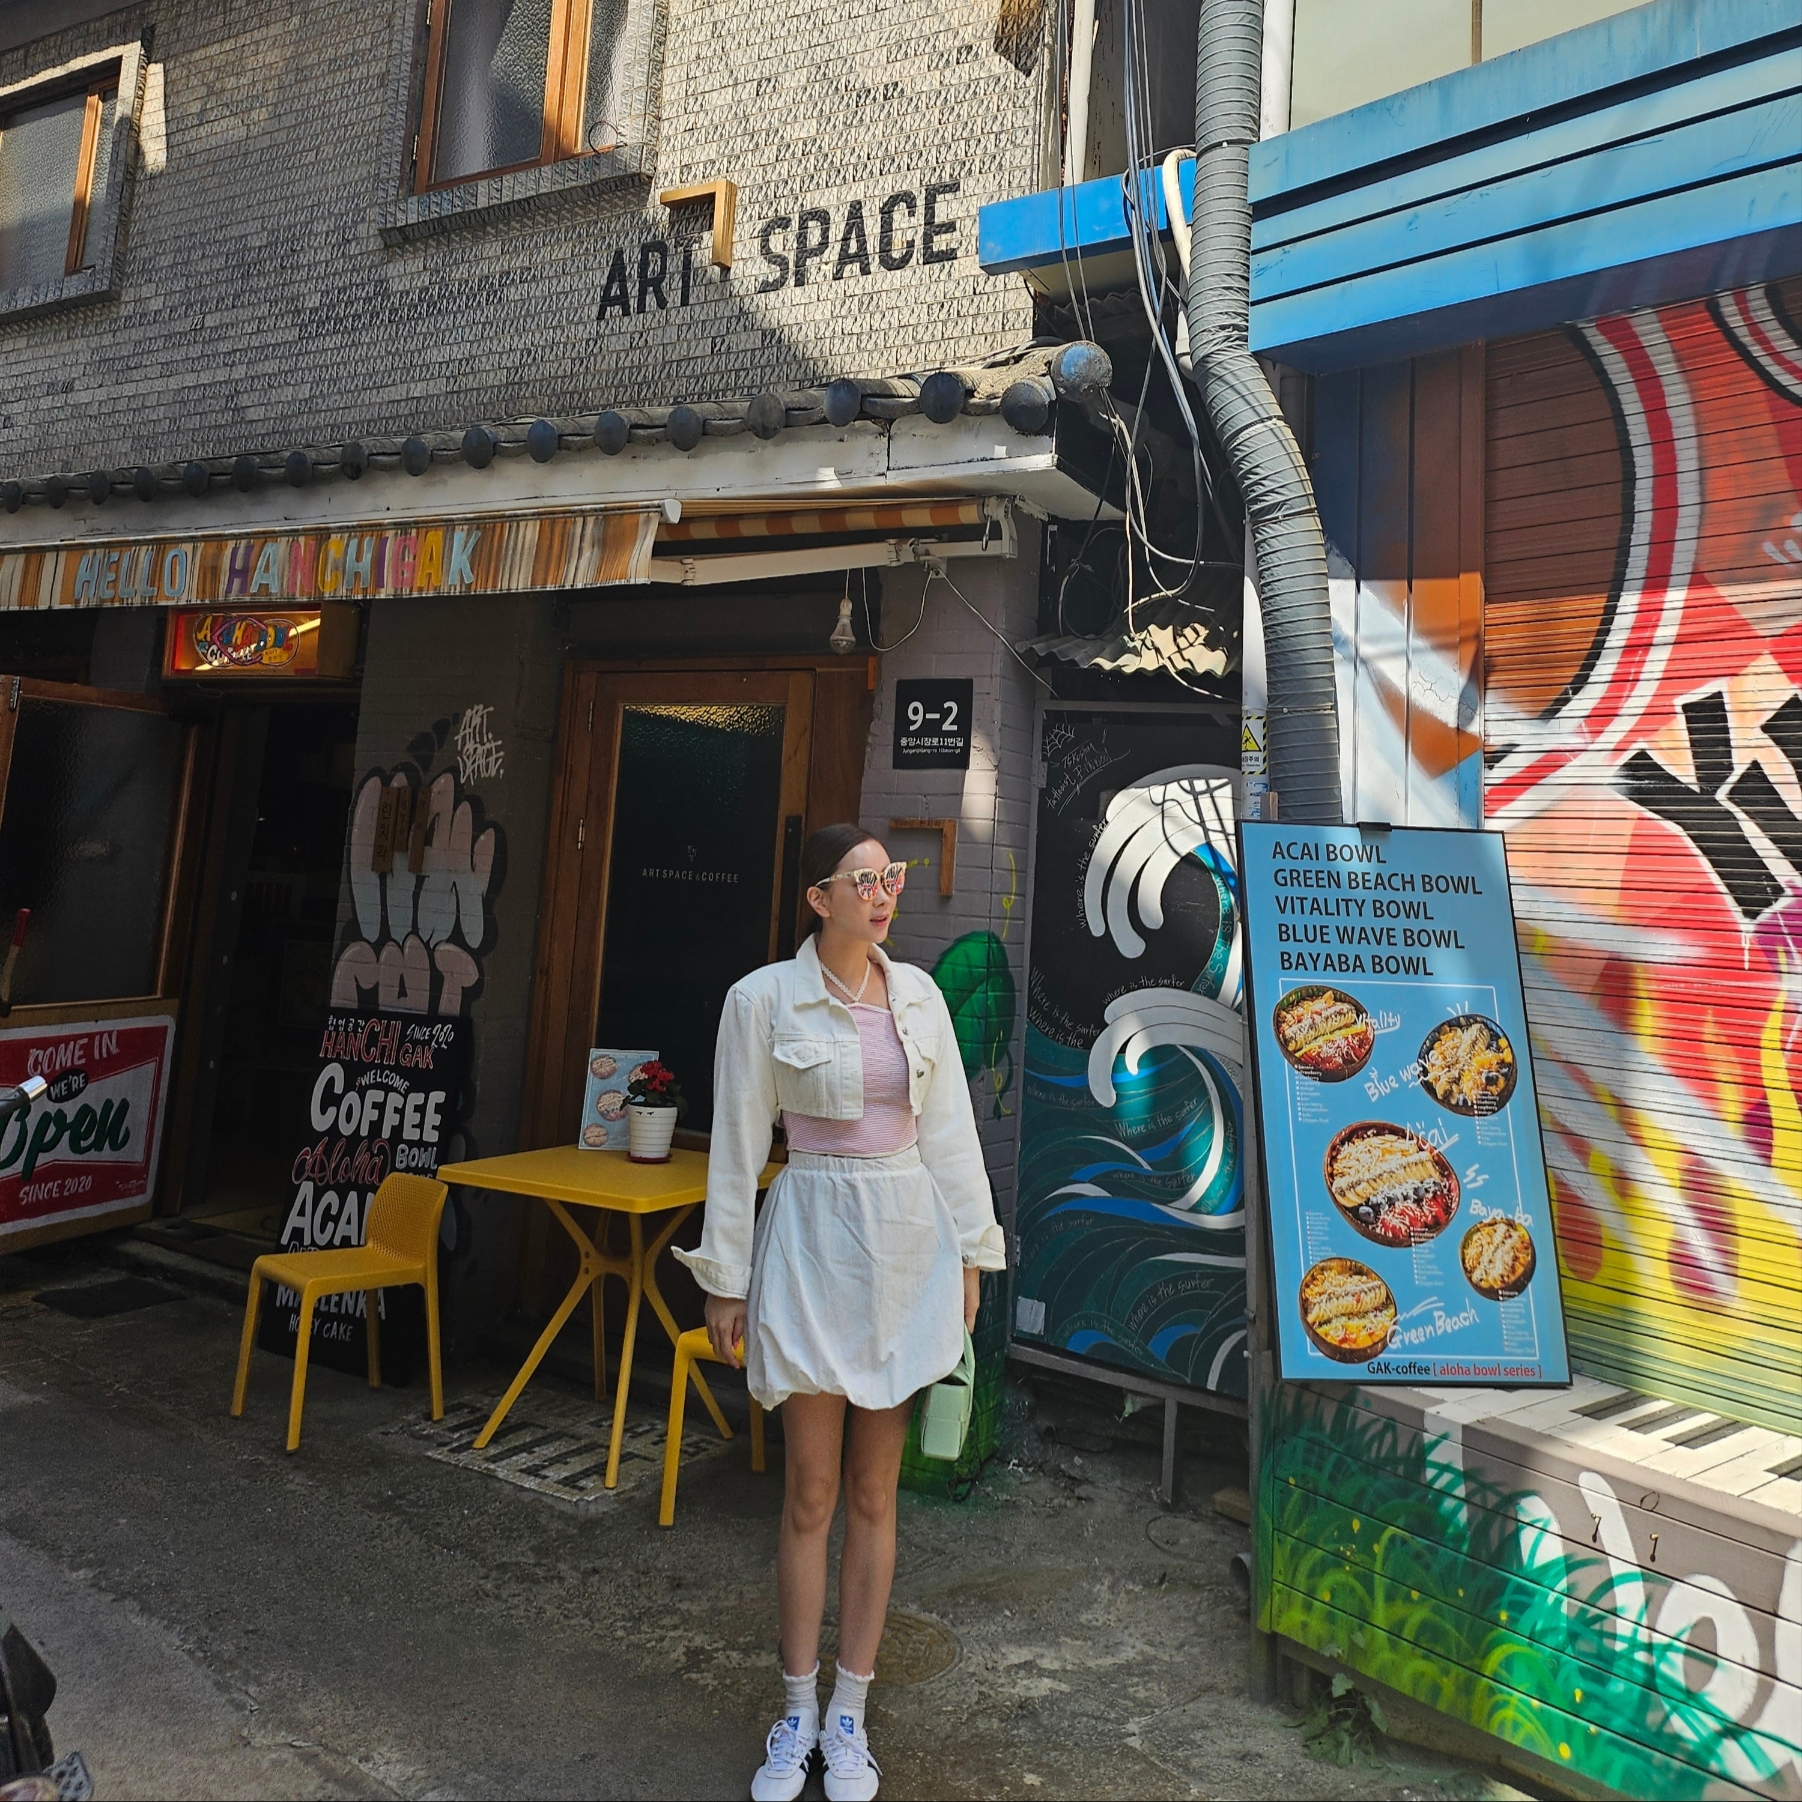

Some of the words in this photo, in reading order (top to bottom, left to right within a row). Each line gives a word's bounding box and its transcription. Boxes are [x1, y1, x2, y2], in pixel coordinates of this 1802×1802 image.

[597, 237, 702, 321] ART
[756, 181, 962, 294] SPACE
[74, 546, 188, 599] HELLO
[225, 529, 481, 596] HANCHIGAK
[907, 701, 959, 731] 9-2
[900, 737, 964, 747] 중앙시장로11번길
[1088, 817, 1109, 849] surfer
[1077, 852, 1091, 871] the
[1272, 841, 1320, 861] ACAI
[1325, 843, 1387, 864] BOWL
[701, 872, 739, 883] COFFEE
[1273, 868, 1342, 889] GREEN
[1347, 871, 1416, 892] BEACH
[1421, 874, 1483, 895] BOWL
[1076, 889, 1088, 929] where
[1216, 877, 1232, 915] where
[1275, 895, 1366, 917] VITALITY
[1372, 899, 1434, 920] BOWL
[1278, 923, 1331, 944] BLUE
[1335, 925, 1398, 946] WAVE
[1402, 928, 1466, 949] BOWL
[1280, 951, 1366, 973] BAYABA
[1371, 954, 1434, 976] BOWL
[1102, 985, 1126, 1005] where
[1129, 982, 1138, 990] is
[1138, 975, 1156, 987] the
[1158, 973, 1185, 987] surfer
[405, 1023, 431, 1042] SINCE
[431, 1023, 455, 1049] 2020
[1059, 1010, 1073, 1030] the
[1076, 1025, 1102, 1037] surfer
[27, 1038, 88, 1077] COME
[94, 1030, 119, 1060] IN
[1066, 1032, 1084, 1049] the
[400, 1042, 434, 1069] GAK
[50, 1072, 87, 1099] WE'RE
[360, 1069, 410, 1095] WELCOME
[1364, 1076, 1399, 1102] Blue
[1400, 1050, 1443, 1082] wave
[310, 1062, 447, 1143] COFFEE
[1114, 1121, 1147, 1138] Where
[1157, 1112, 1173, 1127] the
[1175, 1097, 1198, 1121] surfer
[292, 1137, 391, 1187] Aloha
[395, 1144, 438, 1169] BOWL
[19, 1179, 61, 1206] SINCE
[64, 1175, 93, 1197] 2020
[1157, 1281, 1176, 1300] the
[1177, 1272, 1215, 1296] surfer
[322, 1321, 354, 1343] CAKE
[1367, 1361, 1431, 1376] GAK-coffee
[1439, 1363, 1471, 1377] aloha
[1473, 1364, 1501, 1377] bowl
[1503, 1366, 1536, 1378] series
